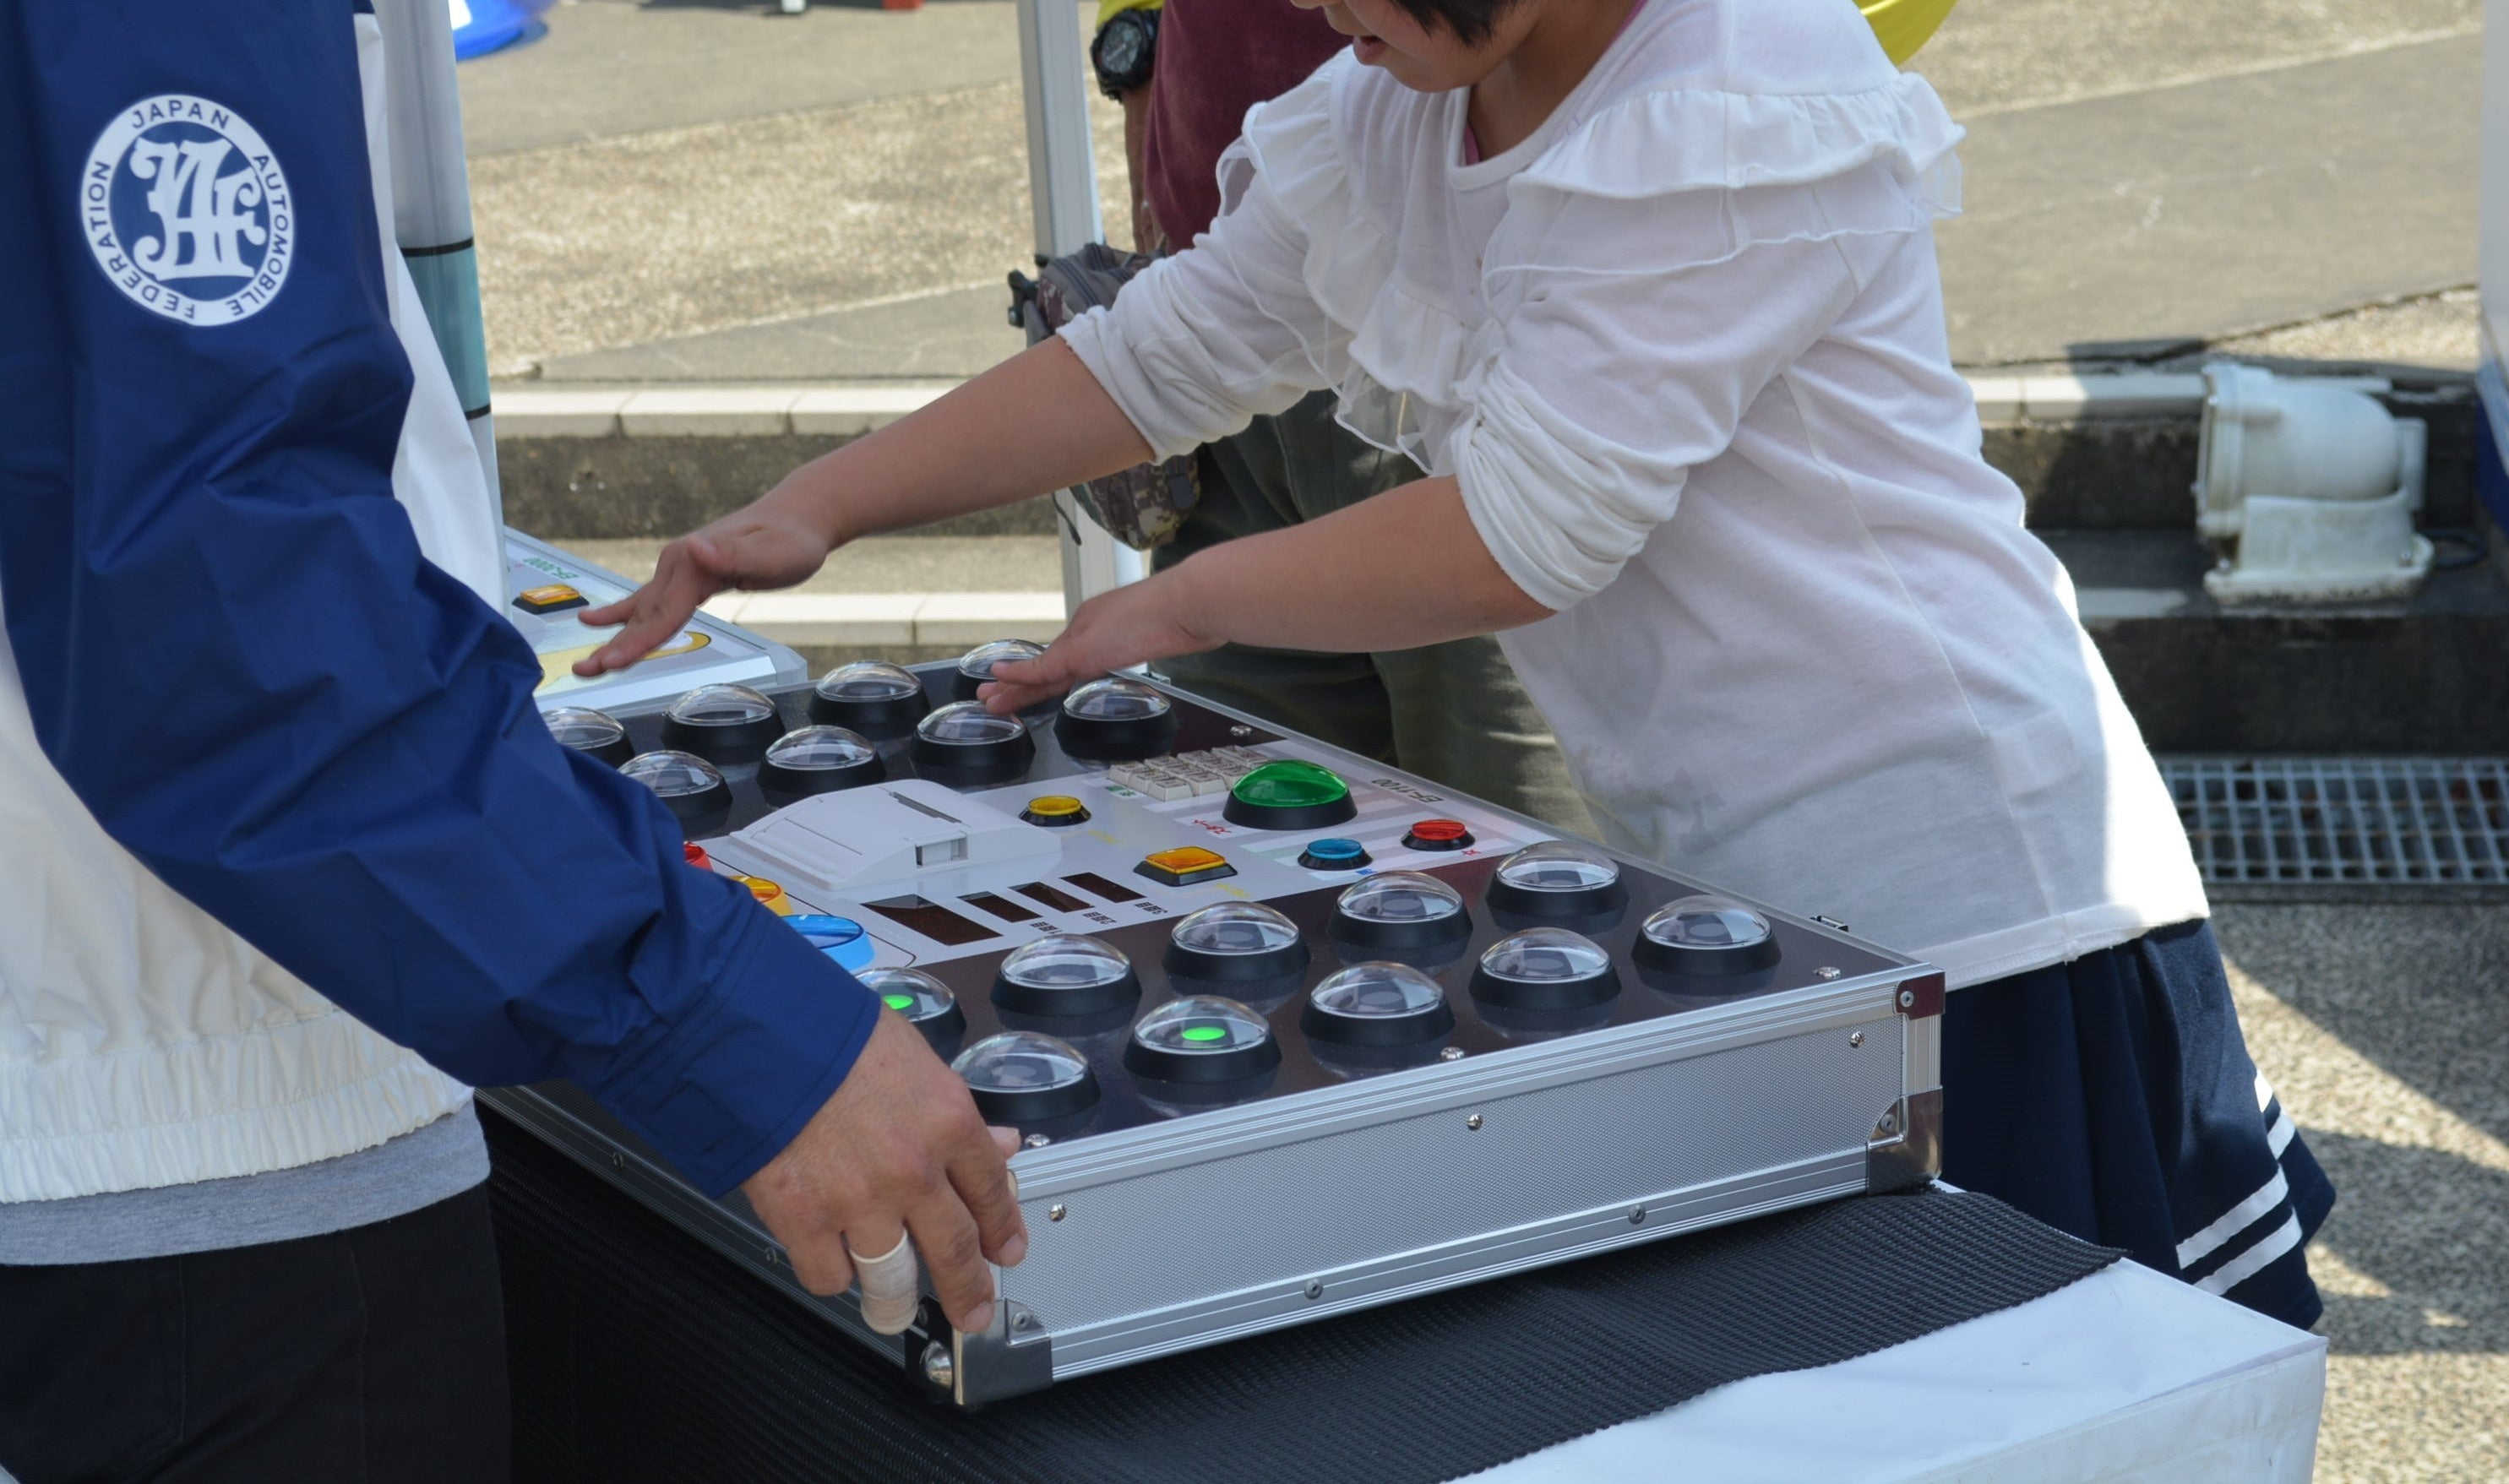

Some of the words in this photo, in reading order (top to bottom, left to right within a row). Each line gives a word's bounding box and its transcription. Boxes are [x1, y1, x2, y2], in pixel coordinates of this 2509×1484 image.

[132, 100, 230, 129] JAPAN
[87, 160, 196, 320] FEDERATION
[225, 155, 289, 317] AUTOMOBILE
